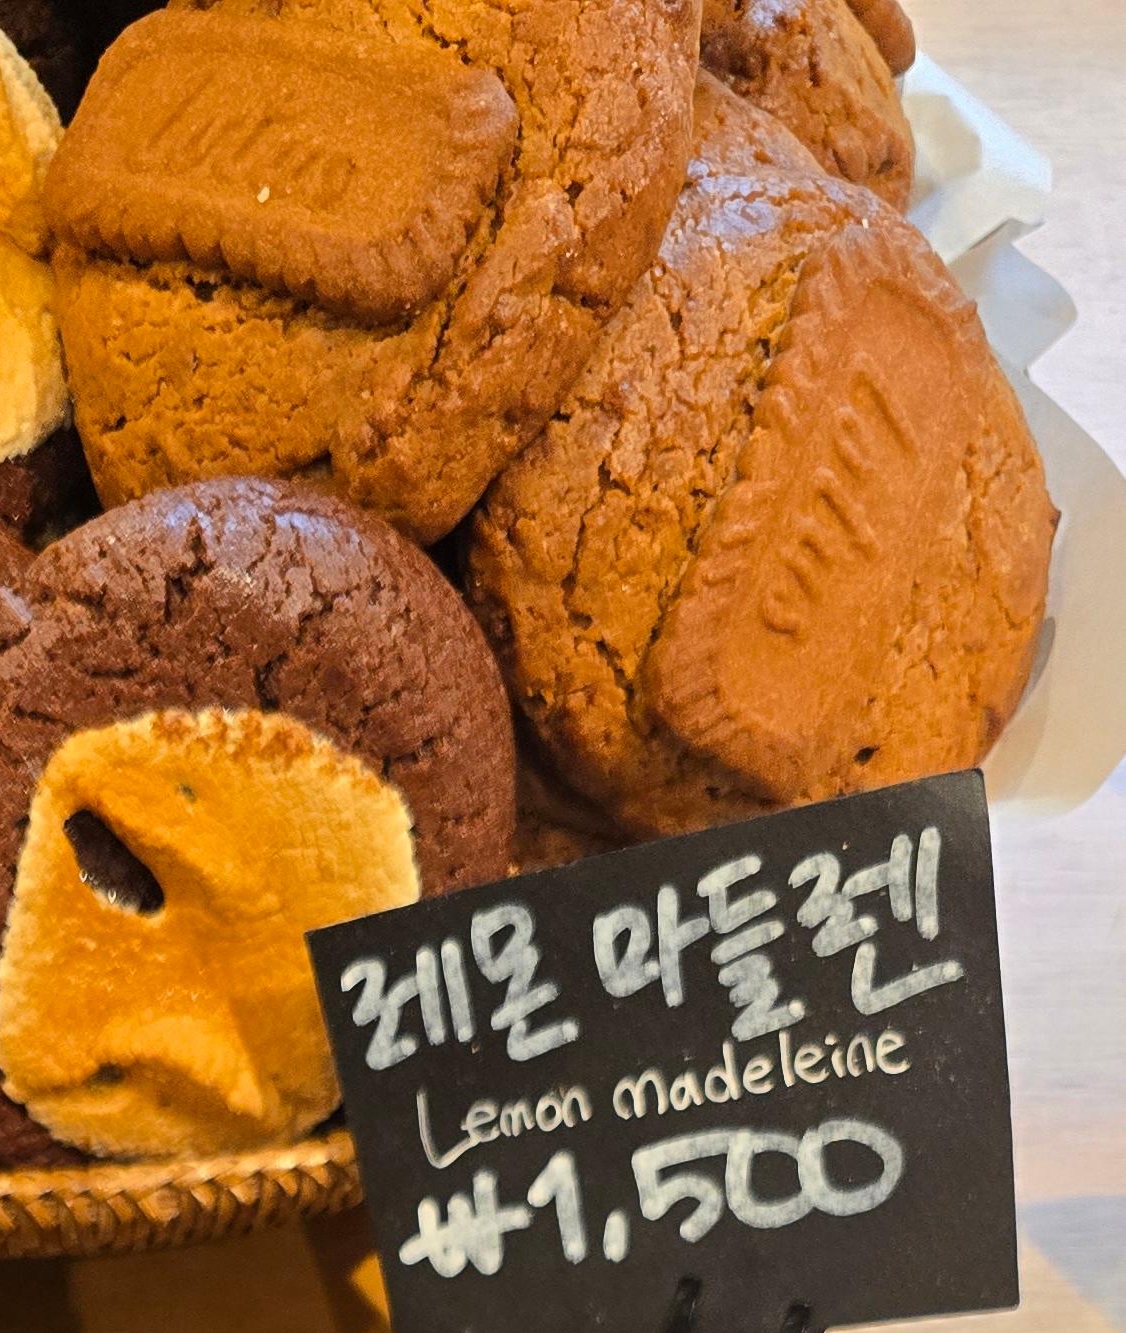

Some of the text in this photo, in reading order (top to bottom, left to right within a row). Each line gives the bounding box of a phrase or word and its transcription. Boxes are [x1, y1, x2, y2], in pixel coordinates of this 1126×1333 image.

[339, 825, 965, 1070] 레몬 마들렌
[399, 1118, 904, 1279] ₩1,500
[415, 1089, 591, 1170] Lemon
